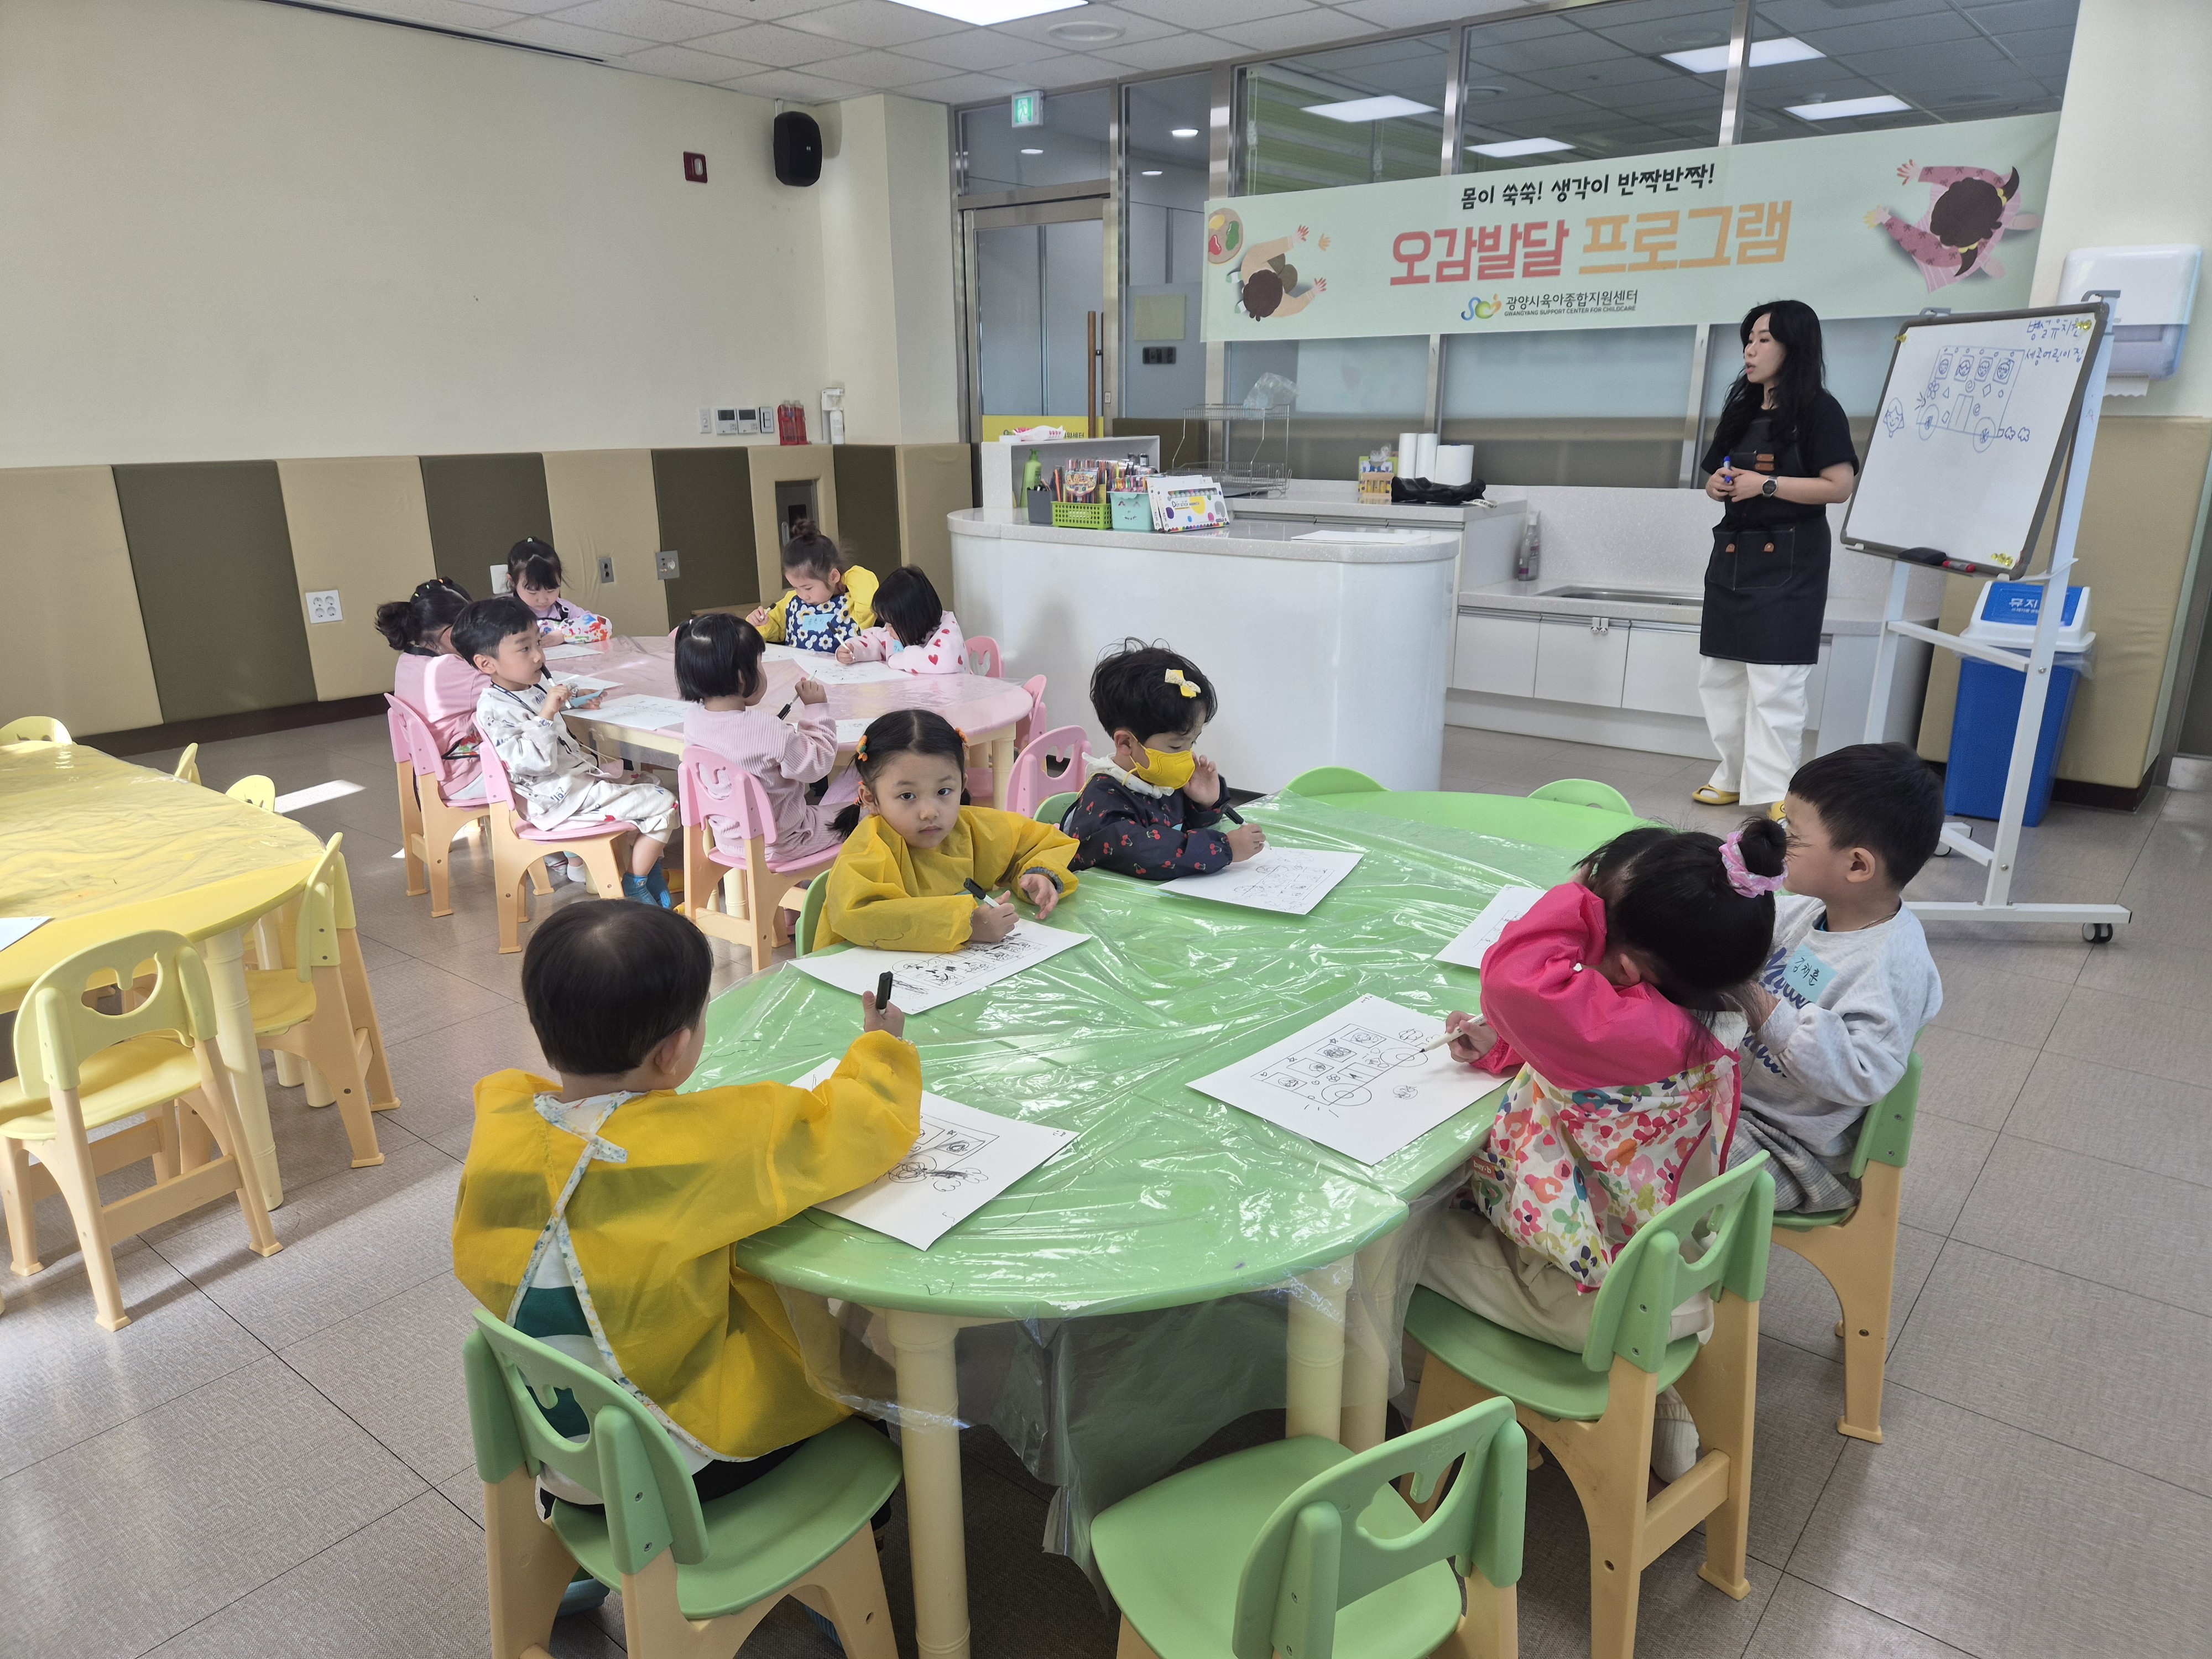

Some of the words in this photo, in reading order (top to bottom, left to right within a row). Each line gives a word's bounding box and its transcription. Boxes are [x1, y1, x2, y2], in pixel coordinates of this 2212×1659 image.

[1461, 186, 1495, 210] 몸이
[1502, 181, 1543, 206] 쑥쑥!
[1551, 174, 1609, 202] 생각이
[1618, 164, 1715, 196] 반짝반짝!
[1390, 219, 1569, 286] 오감발달
[1578, 200, 1793, 275] 프로그램
[1505, 289, 1638, 311] 광양시육아종합지원센터
[1603, 305, 1636, 313] CHILDCARE
[1792, 957, 1820, 986] 김채훈
